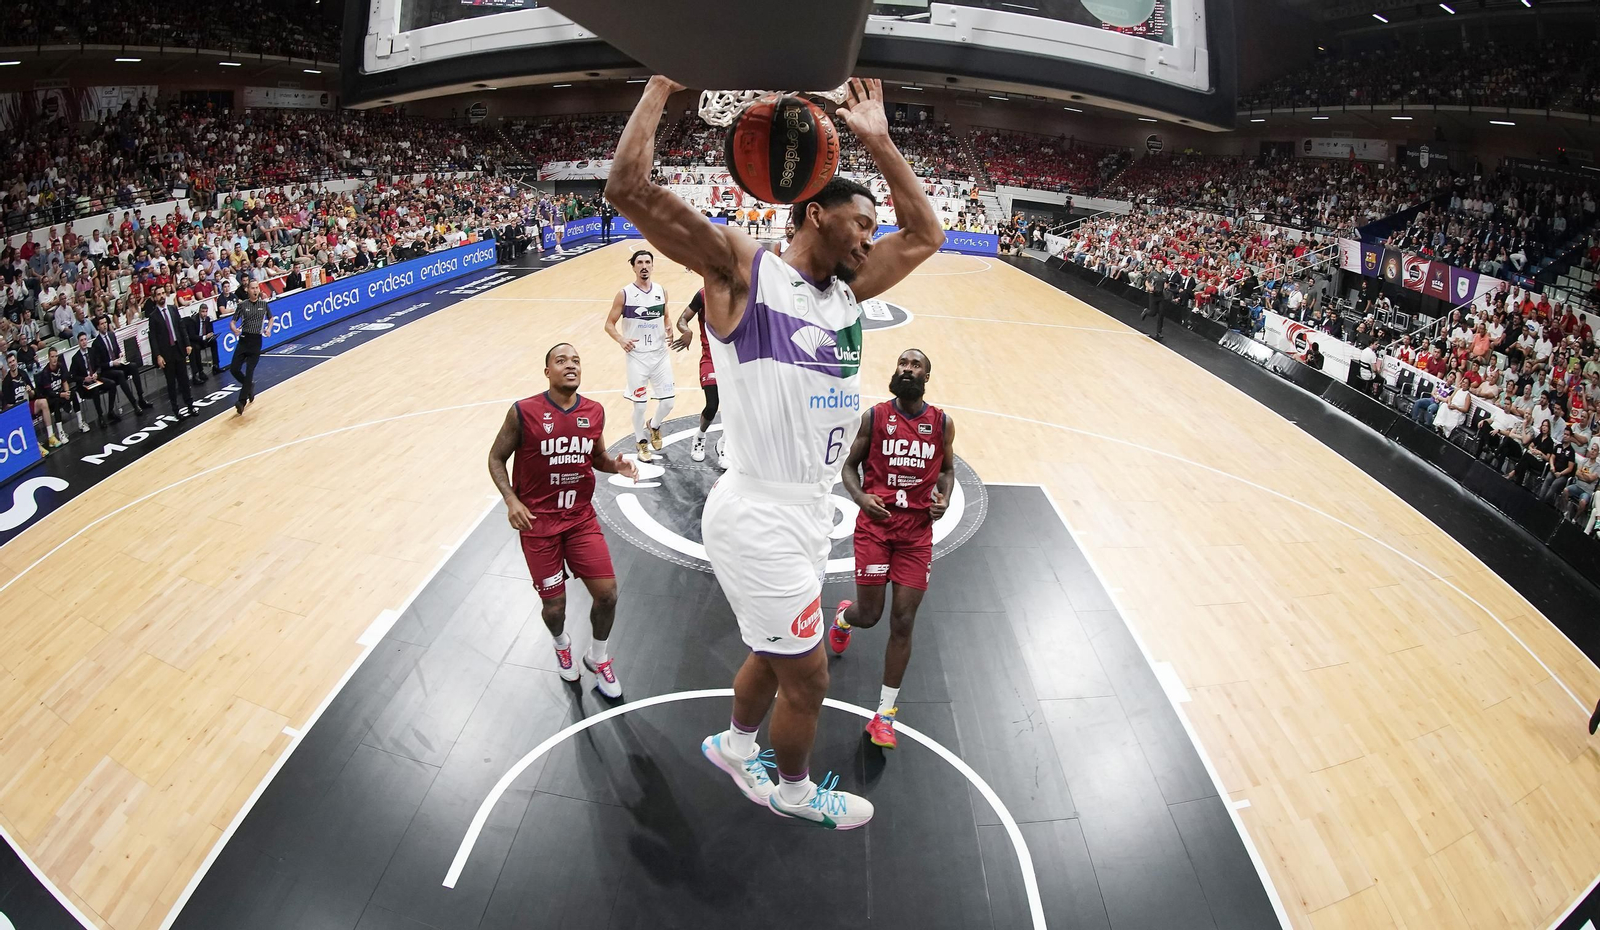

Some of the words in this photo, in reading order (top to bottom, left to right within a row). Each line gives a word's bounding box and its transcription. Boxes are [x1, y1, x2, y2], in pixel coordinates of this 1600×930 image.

[779, 130, 801, 188] endesa
[303, 288, 359, 321] endesa
[368, 270, 414, 298] endesa
[420, 257, 458, 281] endesa
[462, 247, 494, 268] endesa
[644, 334, 652, 346] 14
[808, 388, 860, 411] málag
[540, 436, 595, 456] UCAM
[824, 427, 845, 465] 6
[882, 439, 936, 460] UCAM
[549, 455, 586, 466] MURCIA
[889, 457, 926, 469] MURCIA
[557, 489, 578, 510] 10
[895, 489, 909, 508] 8
